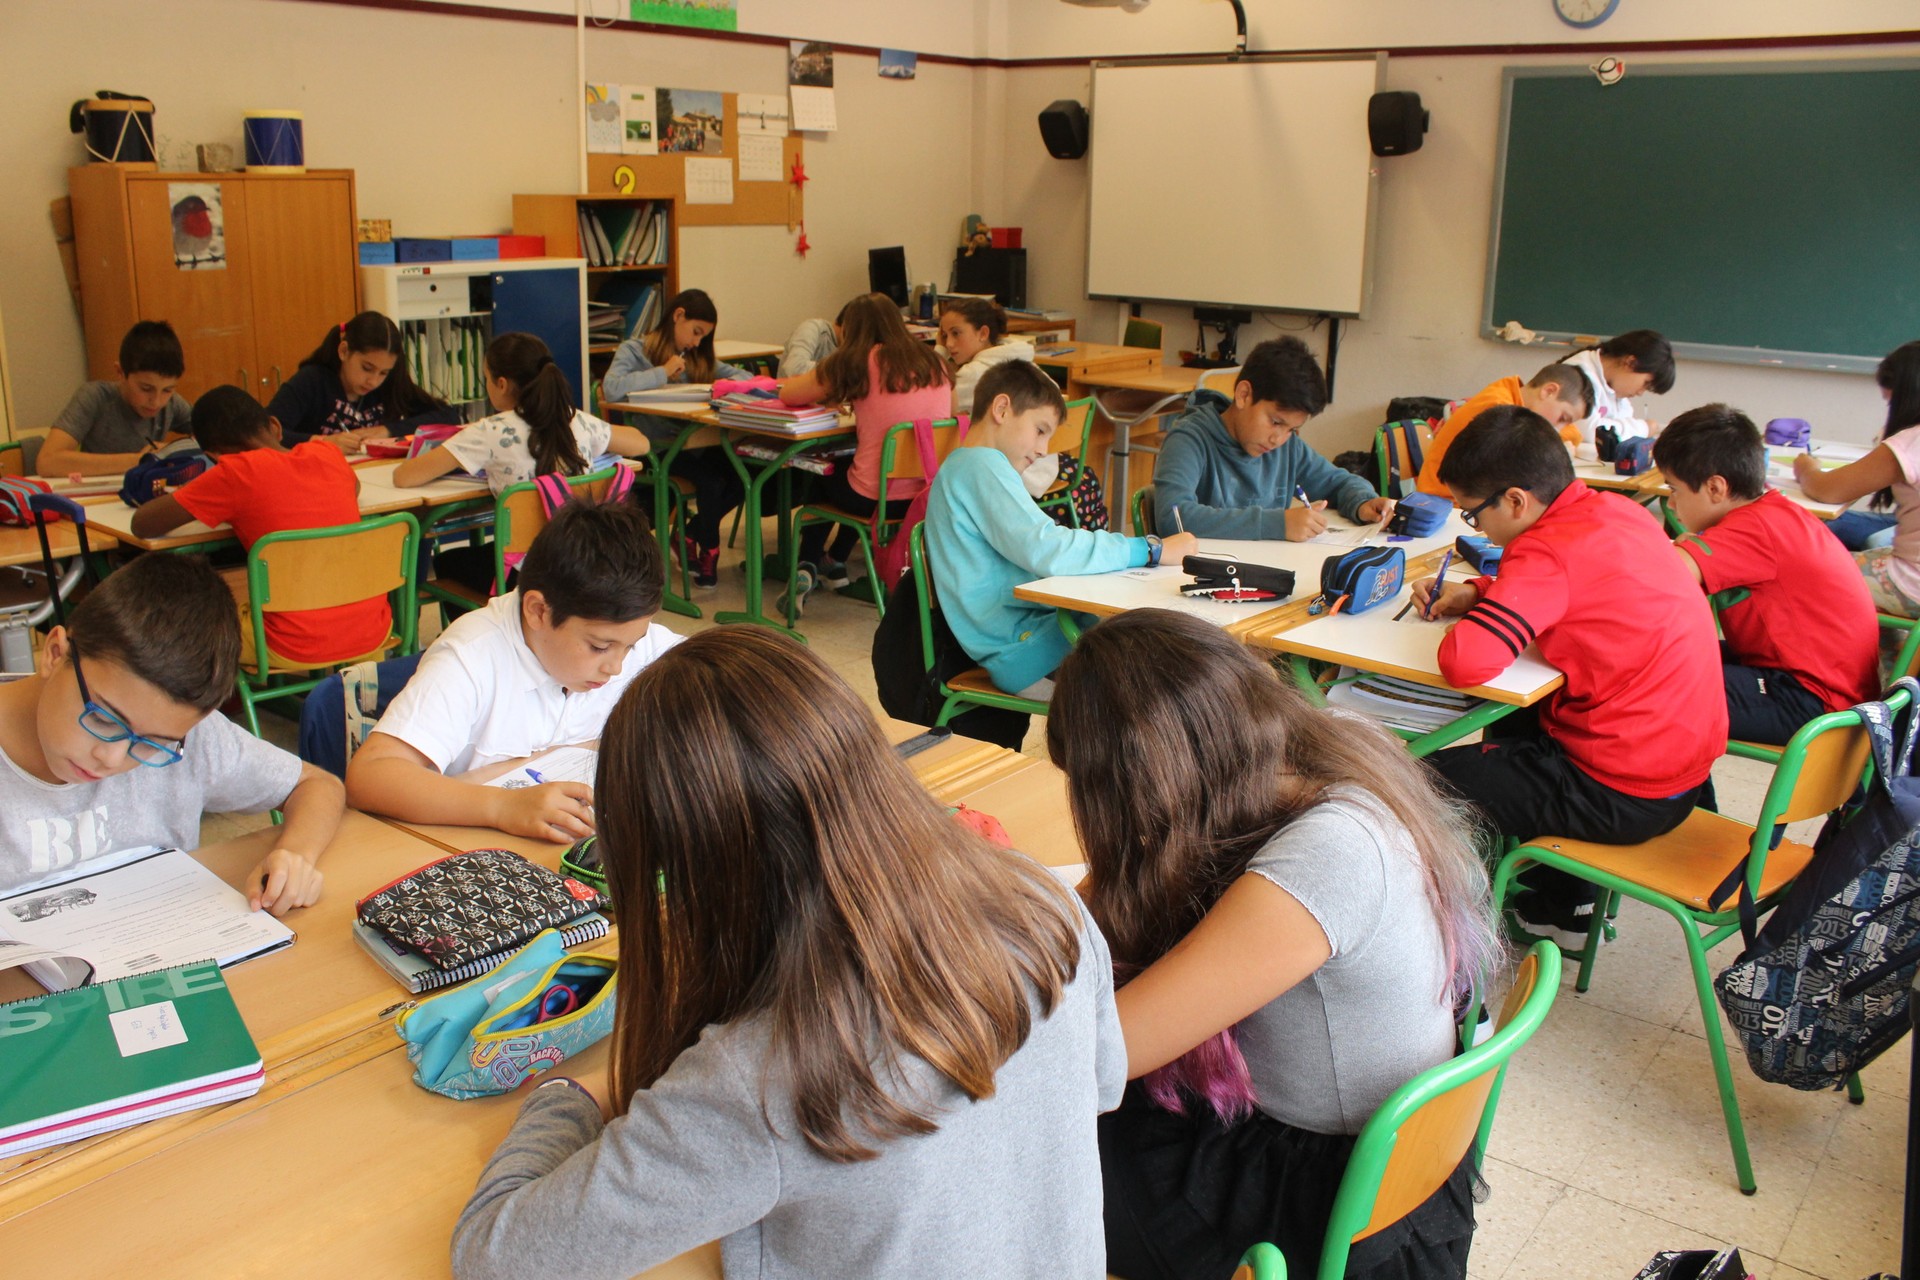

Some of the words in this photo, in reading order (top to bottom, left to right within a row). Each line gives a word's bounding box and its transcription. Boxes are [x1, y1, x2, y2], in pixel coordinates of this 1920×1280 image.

[26, 805, 112, 873] BE
[1809, 918, 1849, 940] 2013
[1727, 1006, 1761, 1030] 2013
[530, 1048, 553, 1064] BACK
